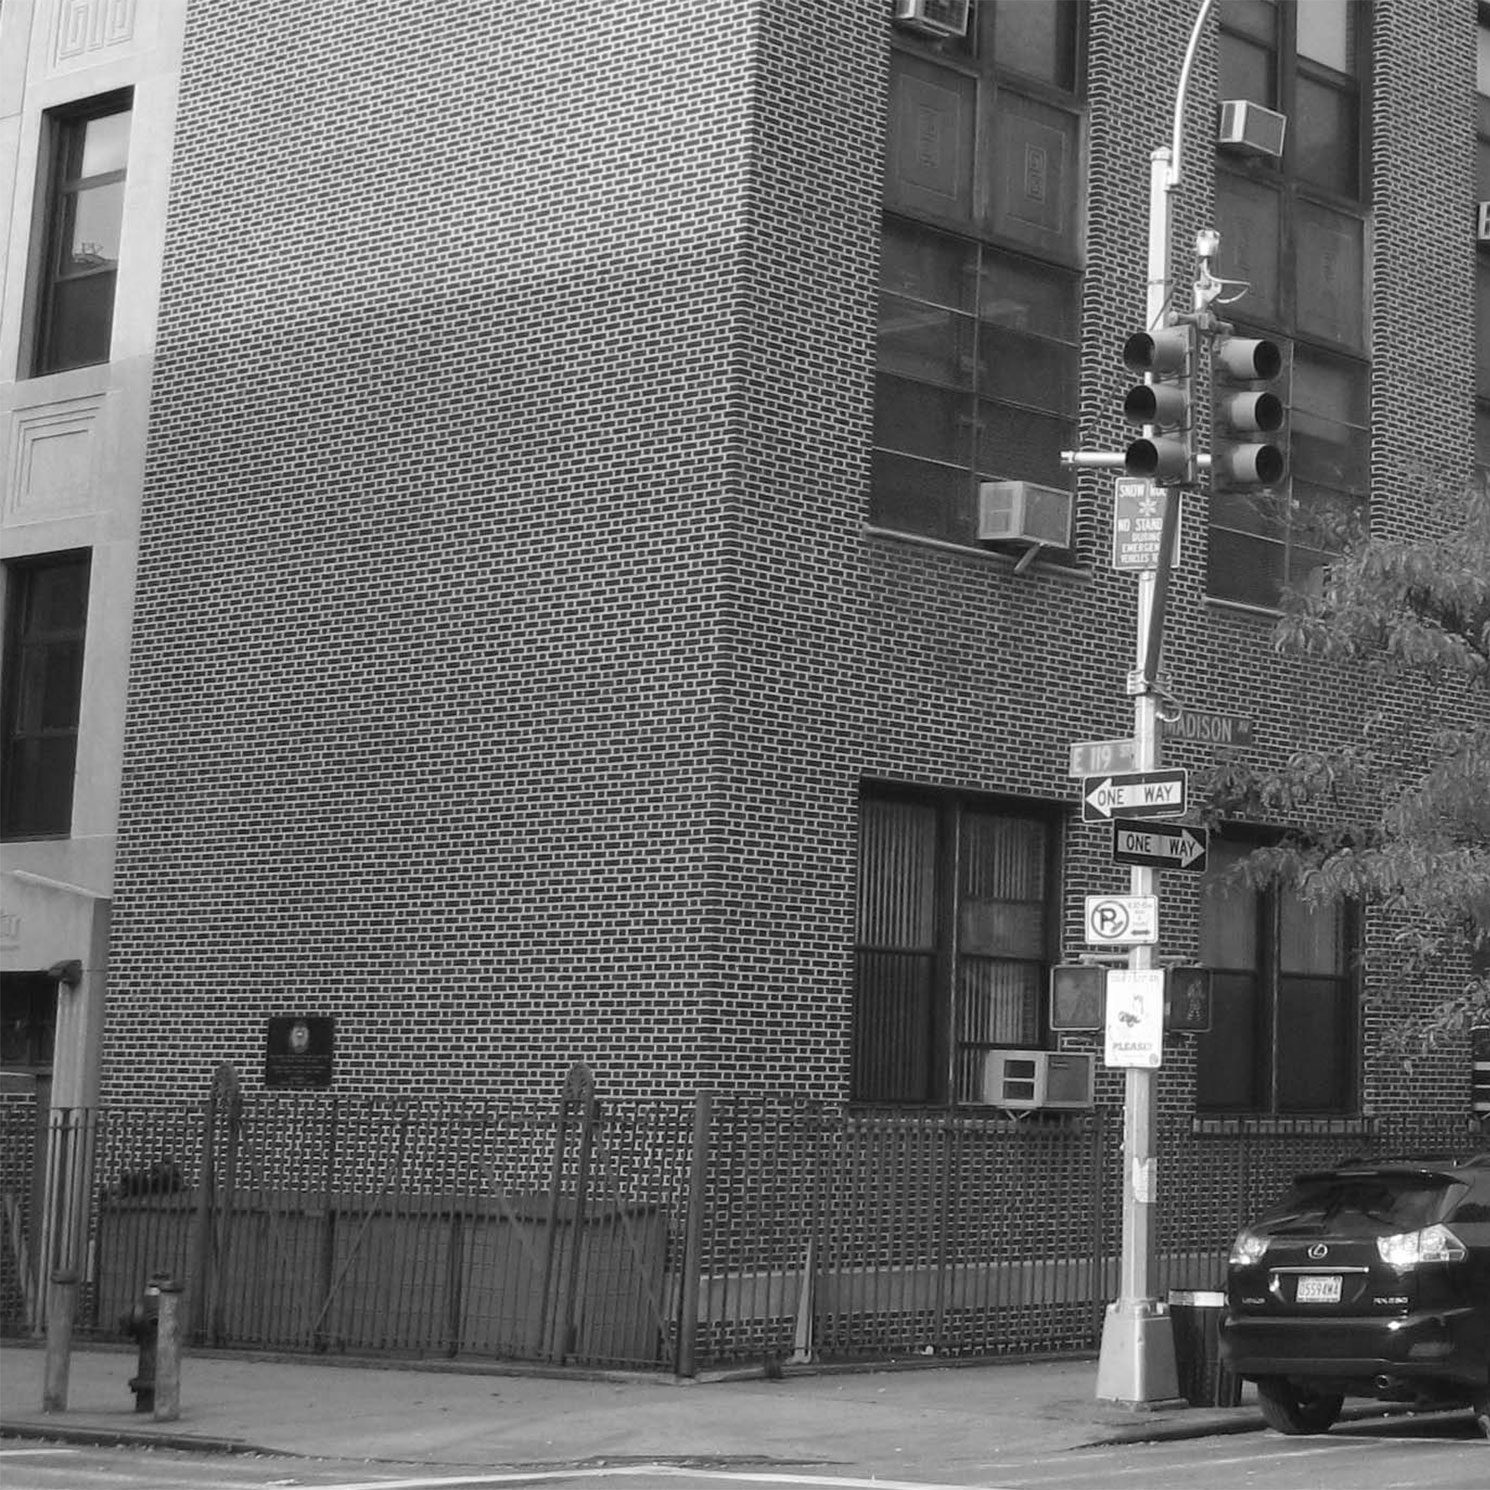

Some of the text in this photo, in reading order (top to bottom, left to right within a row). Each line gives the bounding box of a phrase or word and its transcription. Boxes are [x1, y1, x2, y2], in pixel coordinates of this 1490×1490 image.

[1119, 484, 1145, 497] SNOW
[1118, 518, 1163, 532] NO STAND
[1073, 748, 1084, 772] E
[1090, 746, 1111, 771] 119
[1097, 785, 1174, 806] ONE WAY
[1126, 834, 1196, 857] ONE WAY
